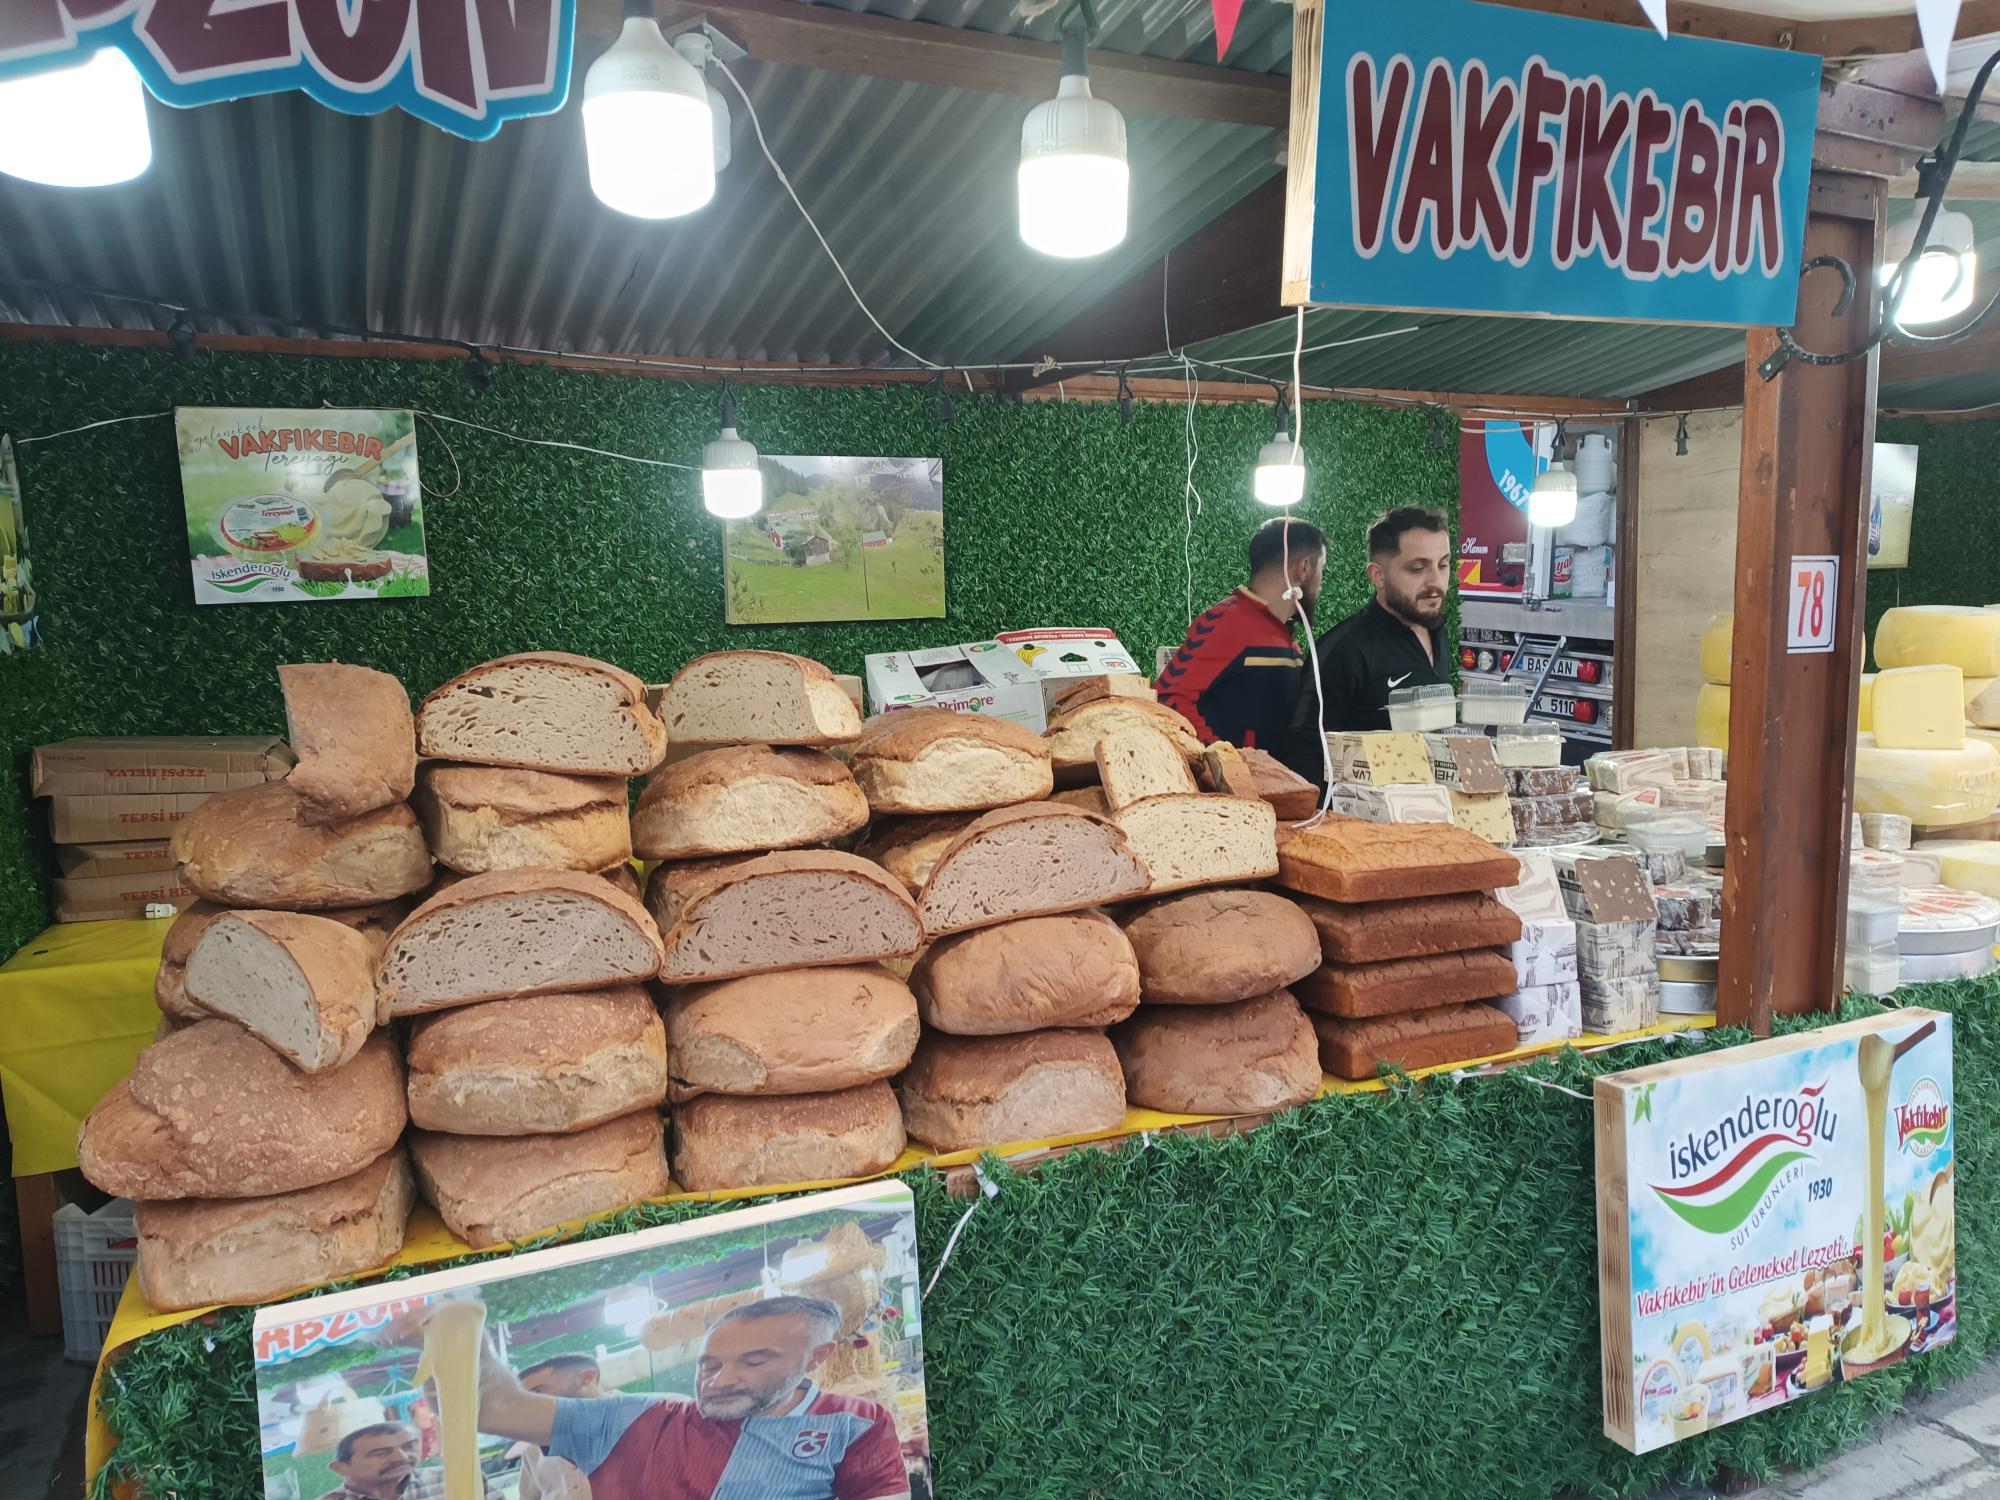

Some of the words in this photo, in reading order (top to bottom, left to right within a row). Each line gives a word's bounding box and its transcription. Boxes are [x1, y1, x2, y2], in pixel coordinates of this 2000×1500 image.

[1347, 51, 1785, 280] VAKFIKEBİR
[218, 428, 384, 461] VAKFIKEBİR
[1498, 468, 1531, 506] 1967
[1797, 570, 1825, 638] 78
[119, 809, 165, 823] TEPSİ
[120, 886, 165, 901] TEPSİ
[1730, 1226, 1751, 1251] SÜT
[1752, 1164, 1805, 1229] ÜRÜNLERİ
[1808, 1177, 1833, 1203] 1930
[1728, 1251, 1798, 1290] Geleneksel
